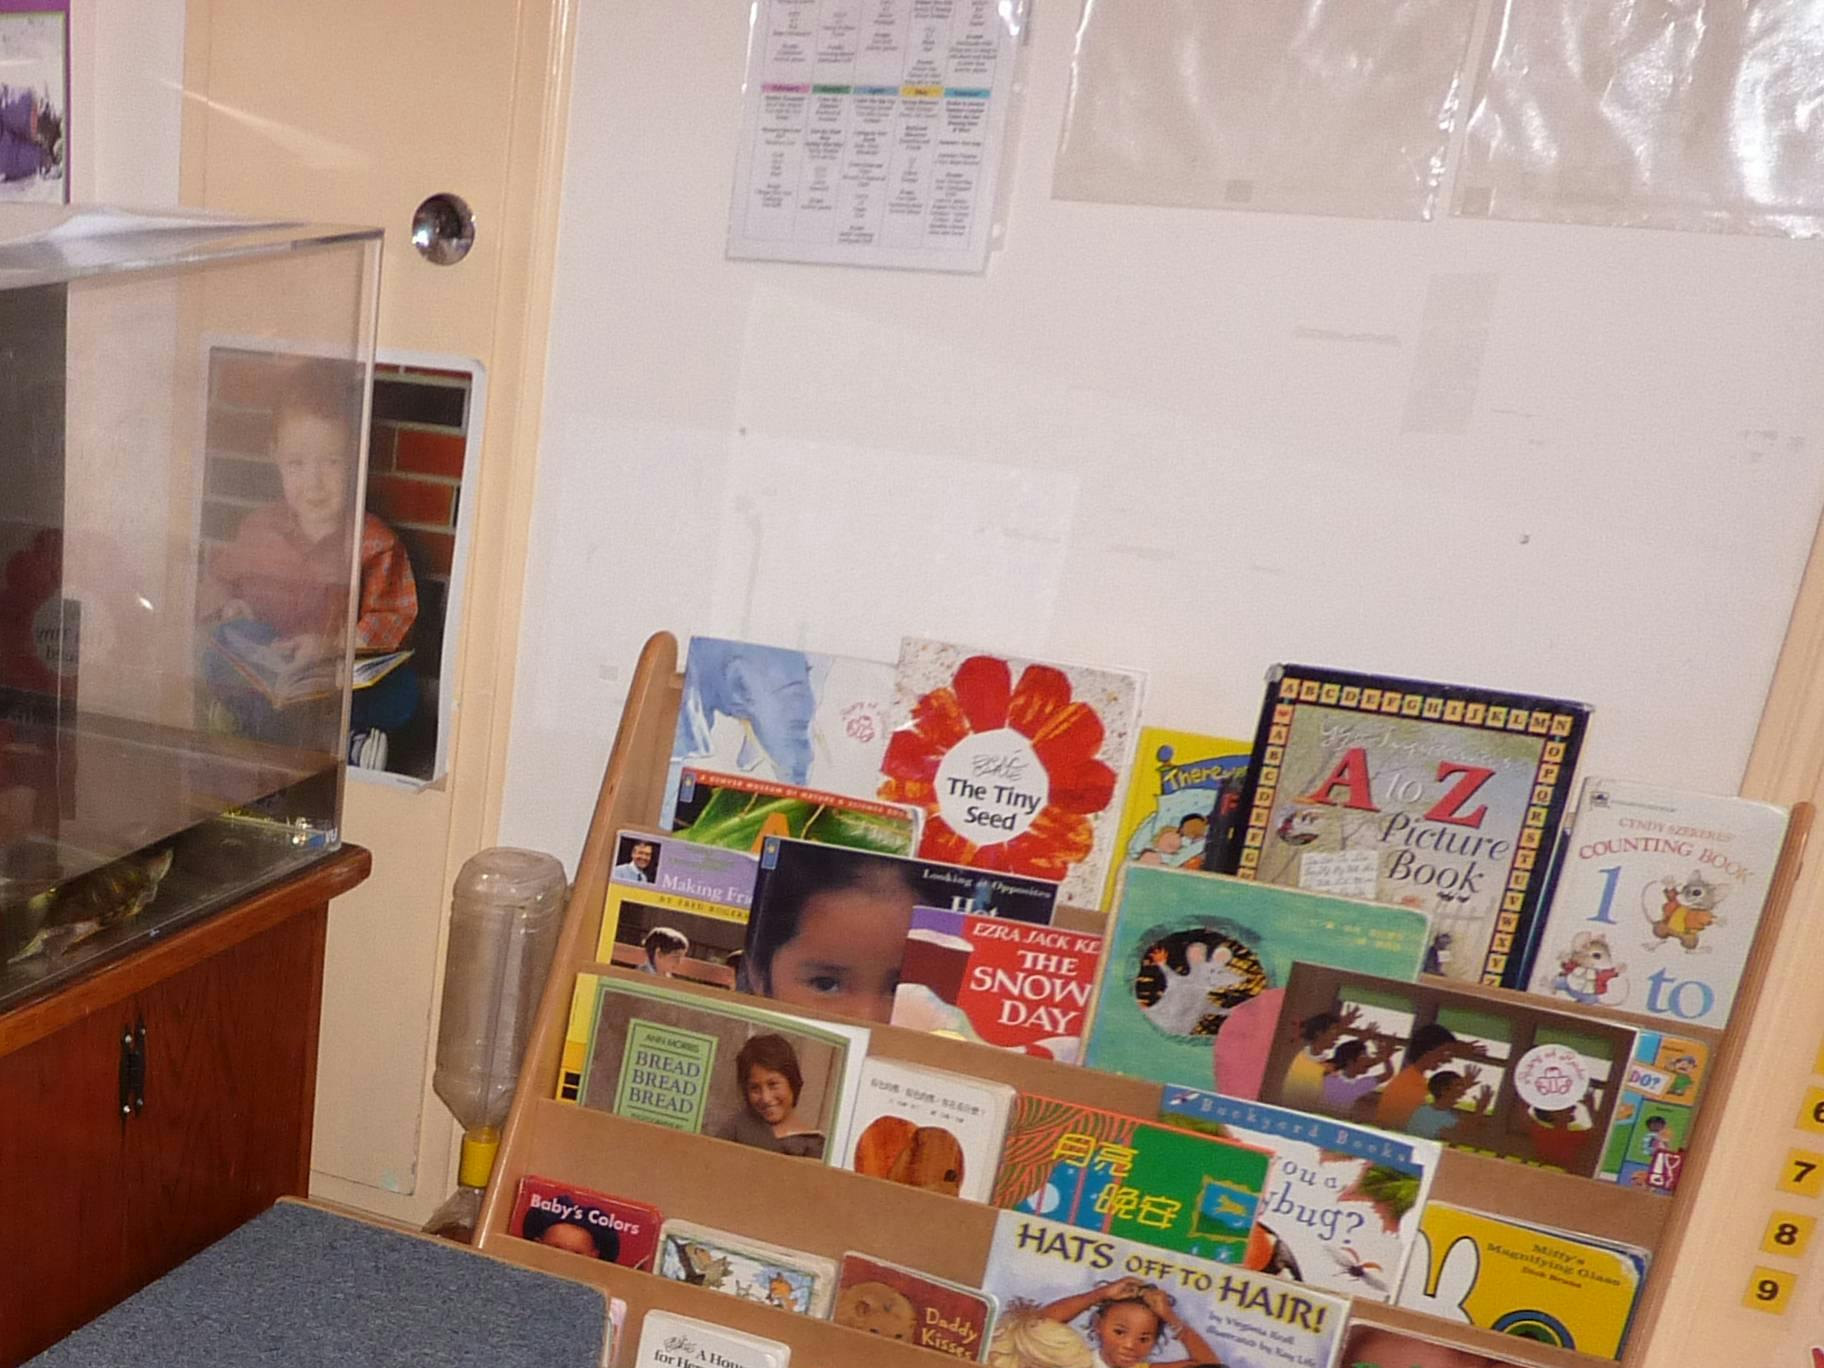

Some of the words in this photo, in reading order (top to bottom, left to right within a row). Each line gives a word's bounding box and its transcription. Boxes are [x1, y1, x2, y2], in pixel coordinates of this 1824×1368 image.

[1163, 765, 1223, 790] There
[1309, 748, 1381, 813] A
[1385, 773, 1423, 805] to
[1424, 760, 1496, 829] Z
[947, 777, 987, 801] The
[994, 786, 1041, 814] Tiny
[964, 806, 1016, 831] Seed
[1379, 811, 1510, 861] Picture
[1388, 848, 1485, 894] Book
[1579, 837, 1693, 860] COUNTING
[1697, 848, 1754, 884] BOOK
[662, 873, 723, 902] Making
[922, 869, 973, 887] Looking
[991, 881, 1052, 899] Opposites
[1586, 865, 1622, 925] 1
[973, 923, 1020, 942] EZRA
[1023, 930, 1070, 950] JACK
[1075, 938, 1101, 954] KE
[1017, 950, 1079, 976] THE
[970, 966, 1093, 1007] SNOW
[1646, 967, 1715, 1019] to
[997, 999, 1080, 1034] DAY
[635, 1050, 701, 1078] BREAD
[632, 1068, 697, 1096] BREAD
[629, 1087, 694, 1115] BREAD
[1200, 1098, 1319, 1139] Backyard
[1336, 1130, 1407, 1163] Books
[1052, 1133, 1139, 1177] 月亮
[1277, 1156, 1316, 1187] ou
[1791, 1159, 1817, 1184] 7
[530, 1193, 584, 1220] Baby's
[588, 1210, 641, 1235] Colors
[1094, 1183, 1183, 1230] 晚安
[1774, 1222, 1799, 1246] 8
[1018, 1222, 1116, 1270] HATS
[1125, 1255, 1175, 1280] OFF
[1180, 1267, 1213, 1292] TO
[1219, 1275, 1329, 1335] HAIR!
[1756, 1279, 1779, 1302] 9
[925, 1306, 977, 1344] Daddy
[654, 1349, 675, 1365] for
[695, 1350, 707, 1362] A
[922, 1327, 973, 1360] Kisses
